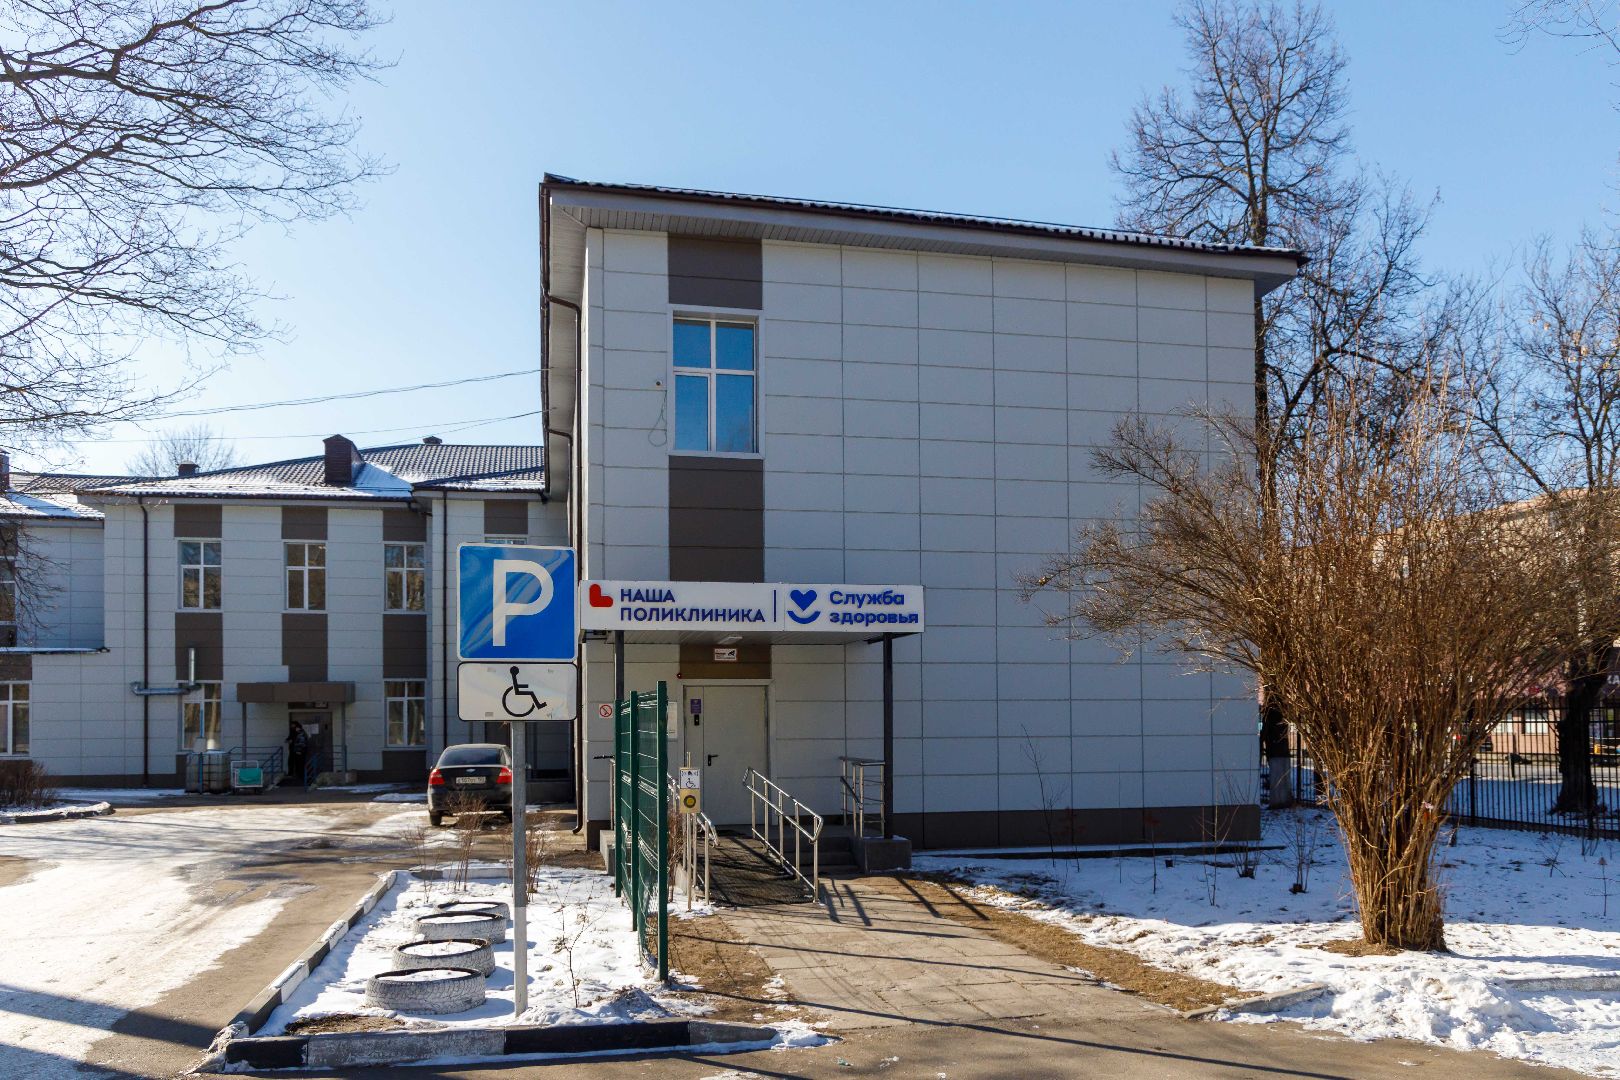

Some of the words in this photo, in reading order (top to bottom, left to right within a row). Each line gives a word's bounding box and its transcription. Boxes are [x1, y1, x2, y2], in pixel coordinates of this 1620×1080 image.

[493, 560, 554, 647] P
[620, 588, 676, 603] НАША
[829, 590, 904, 608] Служба
[620, 607, 765, 623] ПОЛИКЛИНИКА
[829, 612, 919, 627] здоровья
